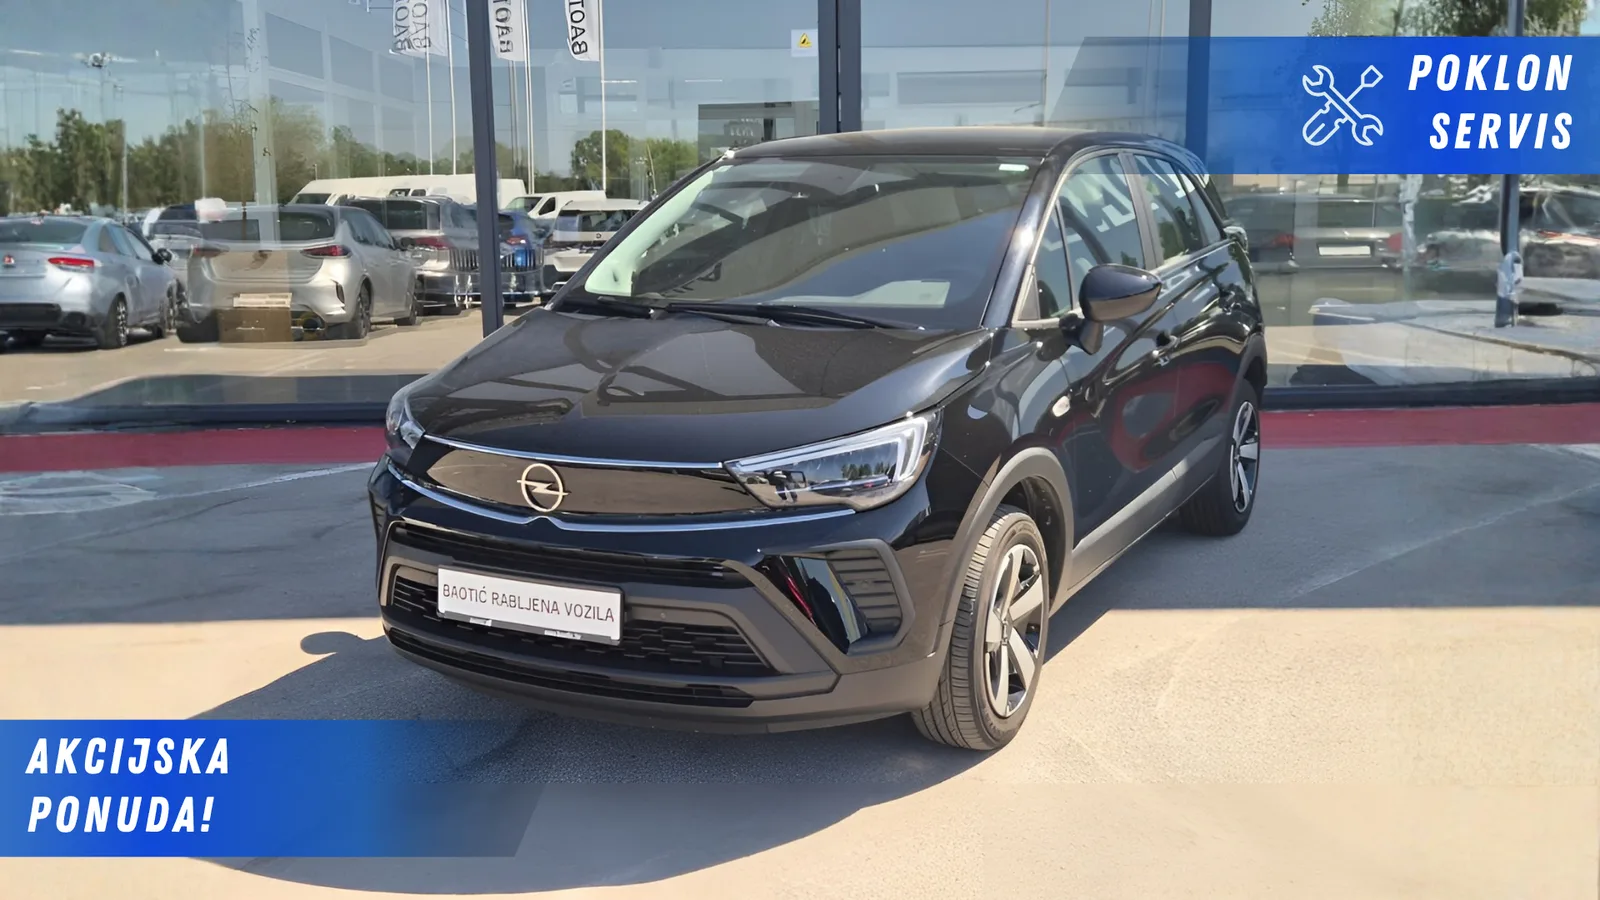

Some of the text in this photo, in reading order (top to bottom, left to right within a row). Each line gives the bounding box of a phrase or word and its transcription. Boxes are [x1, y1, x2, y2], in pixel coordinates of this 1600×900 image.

[442, 583, 615, 623] BAOTIĆ RABLJENA VOZILA
